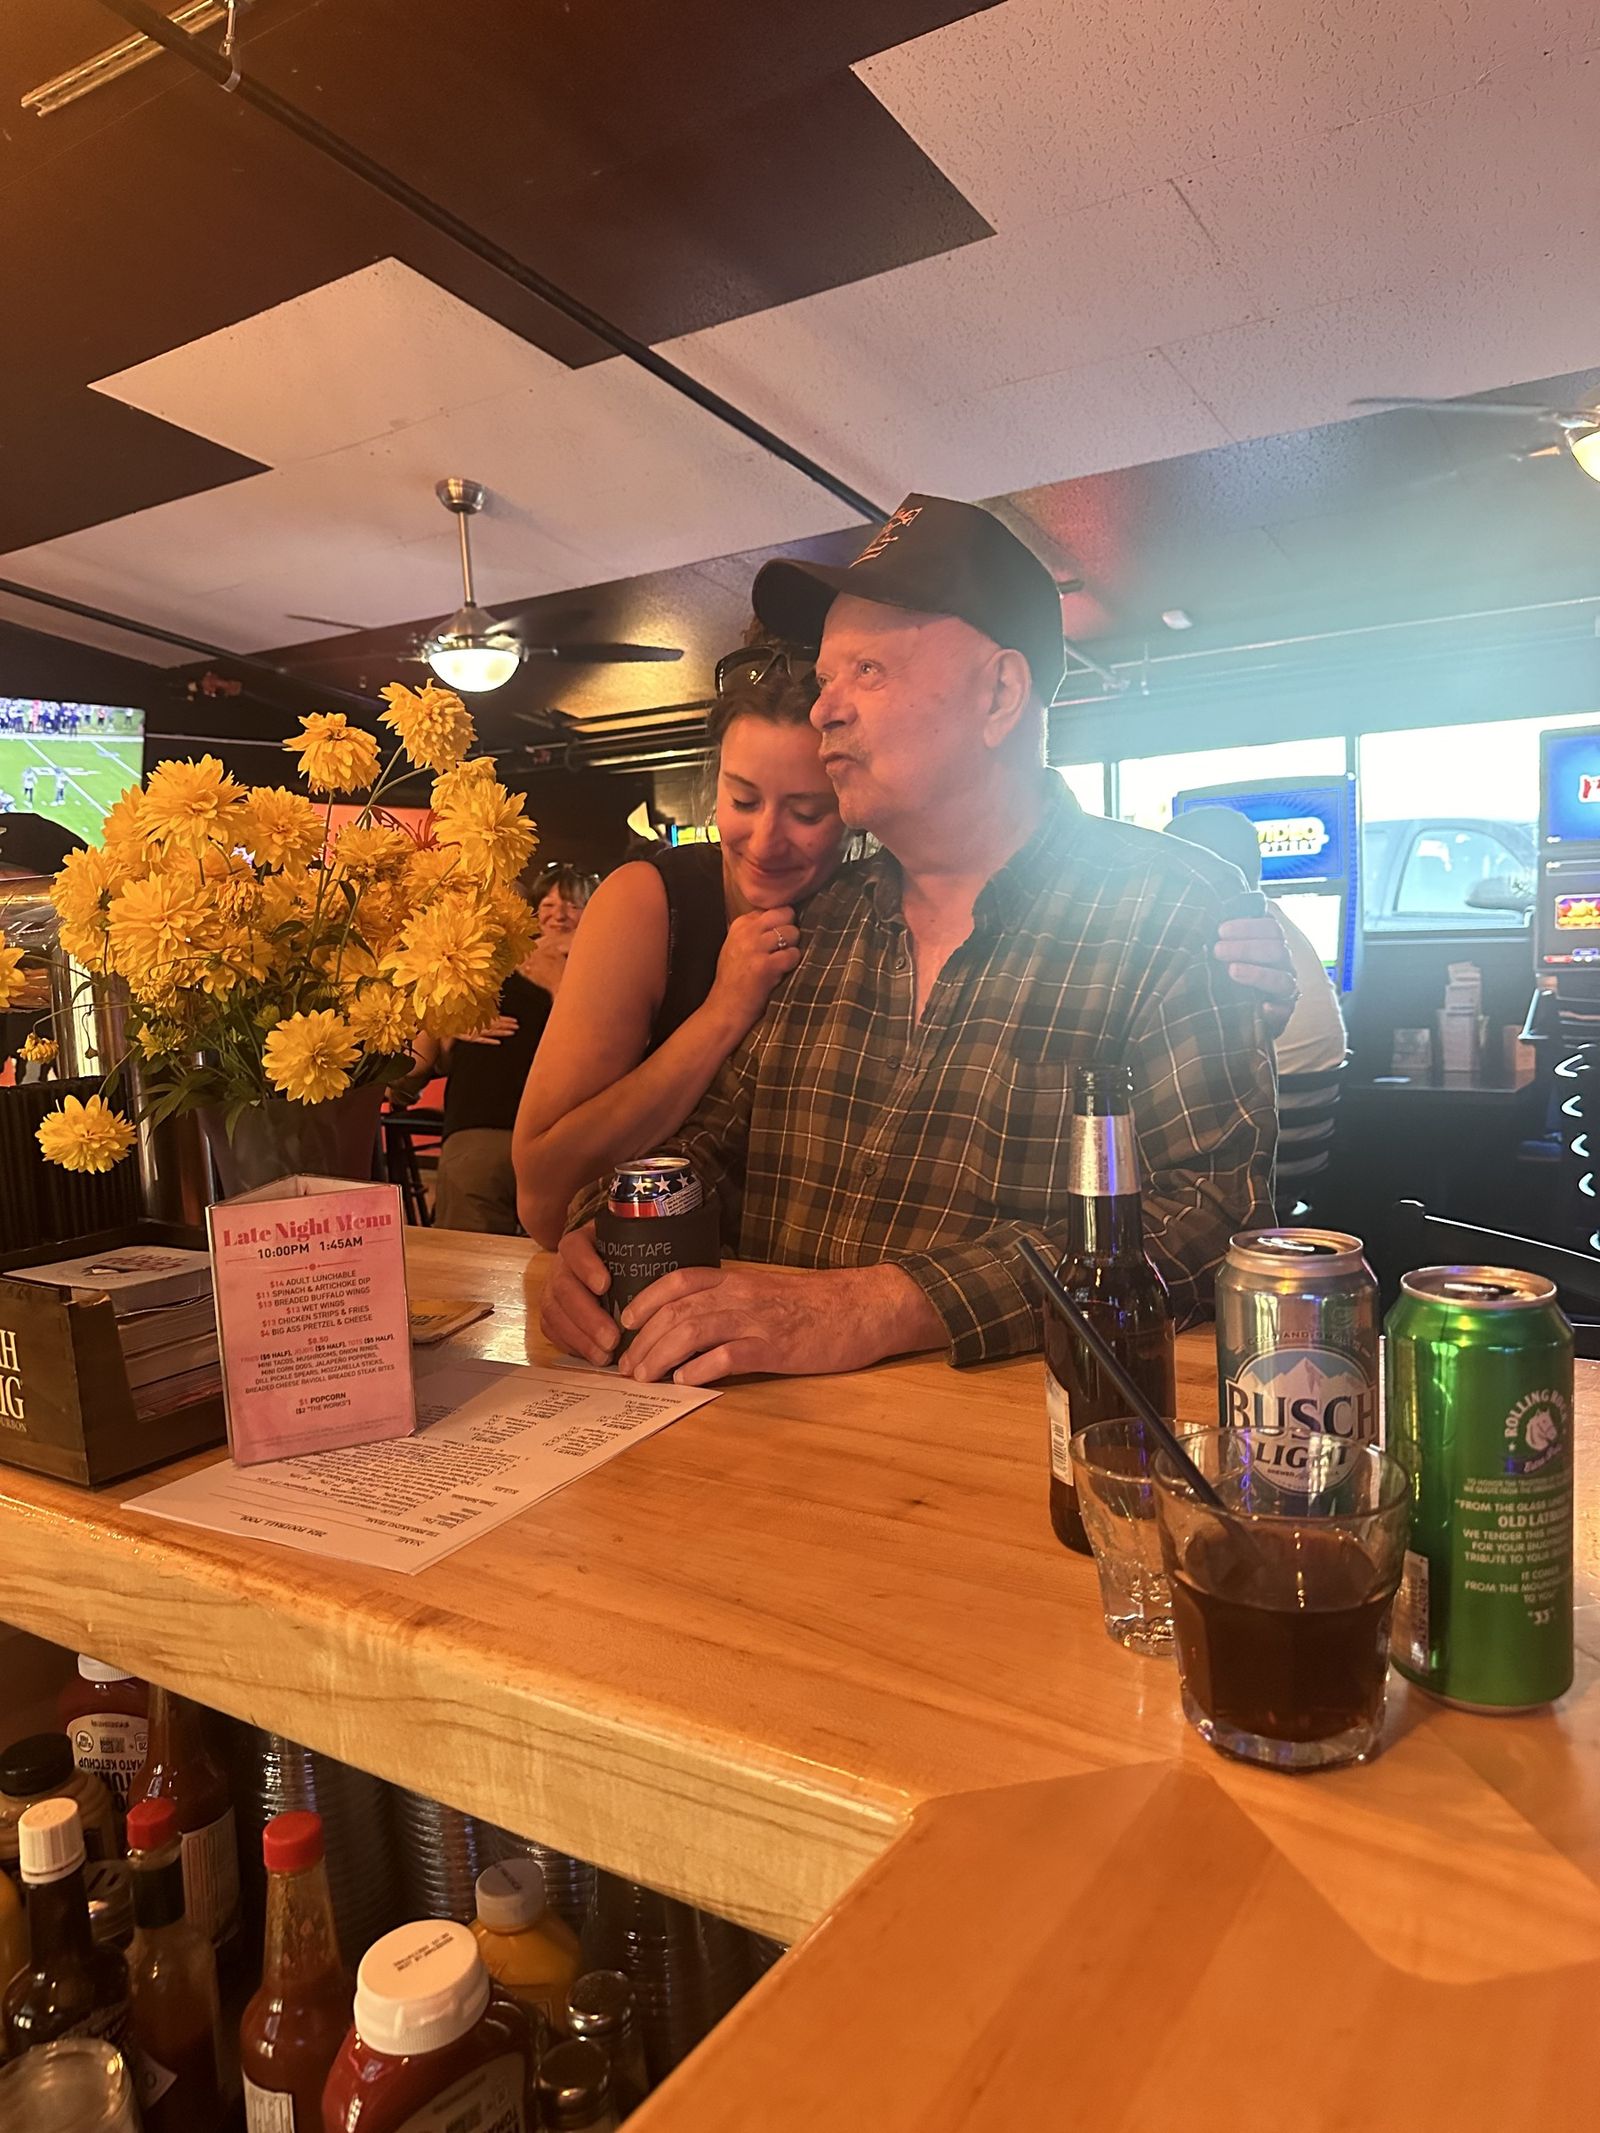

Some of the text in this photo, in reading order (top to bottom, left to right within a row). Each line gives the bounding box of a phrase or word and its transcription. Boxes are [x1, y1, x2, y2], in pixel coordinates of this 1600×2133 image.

[1259, 839, 1319, 853] OTTERY
[223, 1213, 392, 1247] Late Night Menu
[257, 1236, 363, 1259] 10:00PM 1:45AM
[608, 1242, 634, 1257] DUCT
[638, 1242, 672, 1257] TAPE
[609, 1262, 626, 1277] FIX
[285, 1276, 311, 1286] ADULT
[312, 1269, 357, 1283] LUNCHABLE
[272, 1286, 306, 1298] SPINACH
[314, 1278, 357, 1291] ARTICHOKE
[358, 1277, 371, 1285] DIP
[274, 1295, 310, 1307] BREADED
[311, 1291, 345, 1301] BUFFALO
[346, 1286, 371, 1296] WINGS
[301, 1304, 318, 1312] WET
[320, 1299, 345, 1310] WINGS
[277, 1314, 312, 1325] CHICKEN
[313, 1309, 340, 1320] STRIPS
[348, 1305, 370, 1314] FRIES
[272, 1328, 285, 1336] BIG
[286, 1325, 301, 1334] ASS
[303, 1319, 336, 1331] PRETZEL
[344, 1314, 373, 1325] CHEESE
[1283, 1331, 1309, 1339] AND
[258, 1361, 272, 1369] MINI
[339, 1348, 359, 1357] ONION
[255, 1377, 268, 1385] DILL
[270, 1373, 293, 1383] PICKLE
[320, 1363, 360, 1374] MOZZARELLA
[261, 1368, 275, 1376] MINI
[276, 1365, 295, 1374] CORN
[245, 1384, 275, 1394] BREADED
[275, 1380, 300, 1389] CHEESE
[327, 1370, 356, 1381] BREADED
[357, 1367, 377, 1376] STEAK
[377, 1364, 395, 1373] BITES
[310, 1392, 346, 1404] POPCORN
[1228, 1383, 1376, 1441] BUSCH
[1505, 1389, 1549, 1438] ROLLING
[1495, 1501, 1515, 1513] THE
[1516, 1500, 1546, 1512] GLASS
[240, 1514, 262, 1524] POOL
[264, 1518, 307, 1532] FOOTBALL
[1498, 1515, 1527, 1528] OLD
[396, 1536, 424, 1546] NAME
[1463, 1528, 1480, 1539] WE
[1483, 1530, 1522, 1540] TENDER
[1524, 1528, 1545, 1539] THIS
[1472, 1541, 1493, 1551] FOR
[1496, 1542, 1525, 1552] YOUR
[1464, 1551, 1506, 1564] TRIBUTE
[1509, 1554, 1523, 1564] TO
[1465, 1580, 1496, 1592] FROM
[1500, 1583, 1519, 1593] THE
[79, 1757, 119, 1770] KETCHUP
